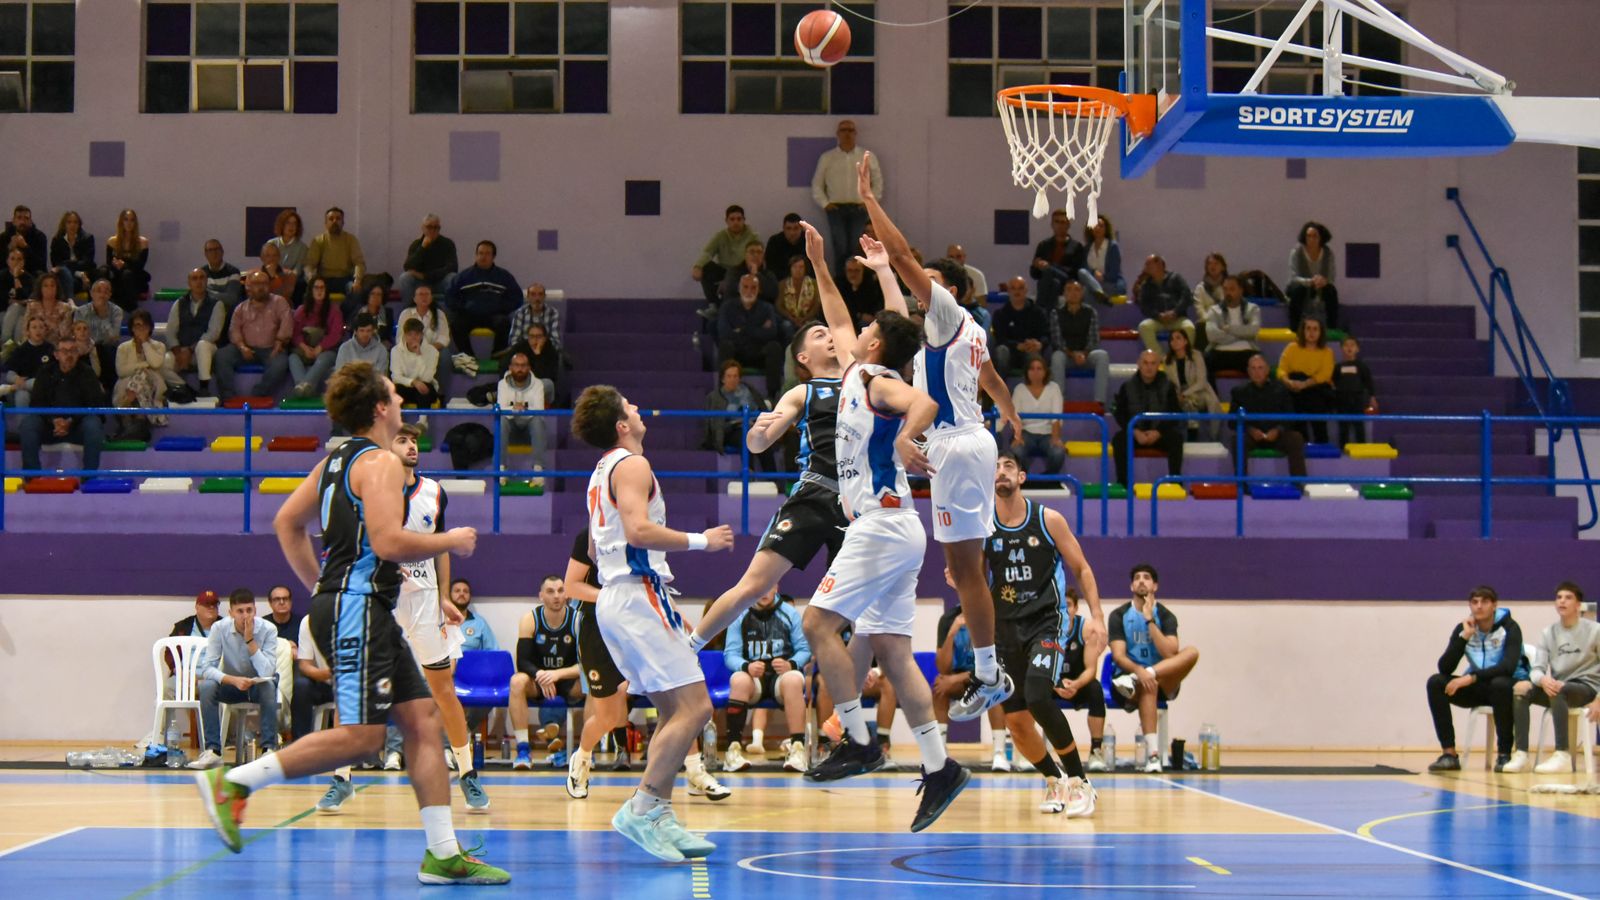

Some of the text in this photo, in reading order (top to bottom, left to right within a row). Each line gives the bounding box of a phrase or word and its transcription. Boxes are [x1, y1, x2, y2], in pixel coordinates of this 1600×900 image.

[1238, 106, 1415, 132] SPORT SYSTEM
[937, 511, 952, 527] 10
[1008, 548, 1026, 564] 44
[1004, 565, 1033, 583] ULB
[337, 637, 360, 674] ULB
[549, 643, 558, 656] 4
[747, 639, 785, 661] ULB
[543, 656, 565, 669] ULB
[1031, 653, 1052, 670] 44
